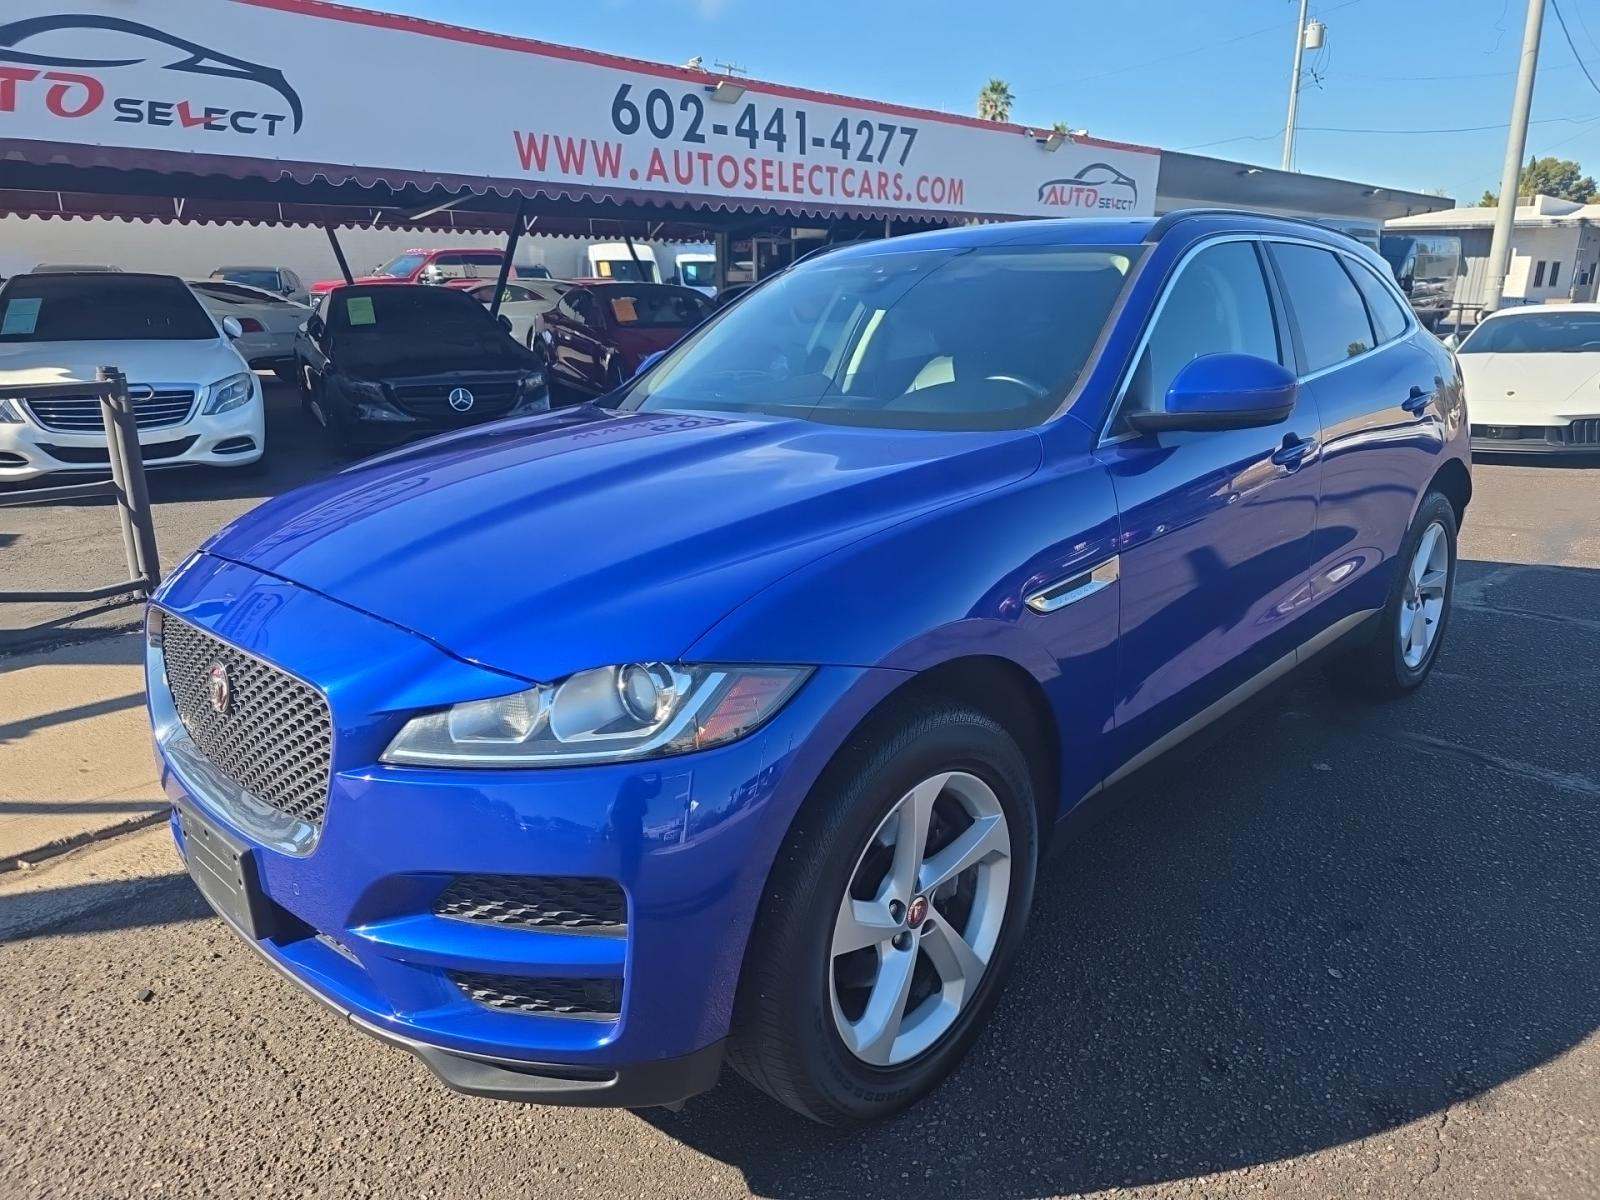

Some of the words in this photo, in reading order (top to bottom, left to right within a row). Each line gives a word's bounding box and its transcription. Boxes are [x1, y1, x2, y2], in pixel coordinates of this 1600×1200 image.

[113, 97, 286, 136] SELECT
[611, 83, 918, 166] 602-441-4277
[513, 130, 964, 205] WWW.AUTOSELECTCARS.COM
[1044, 185, 1098, 208] AUTO
[1098, 197, 1133, 211] SELECT
